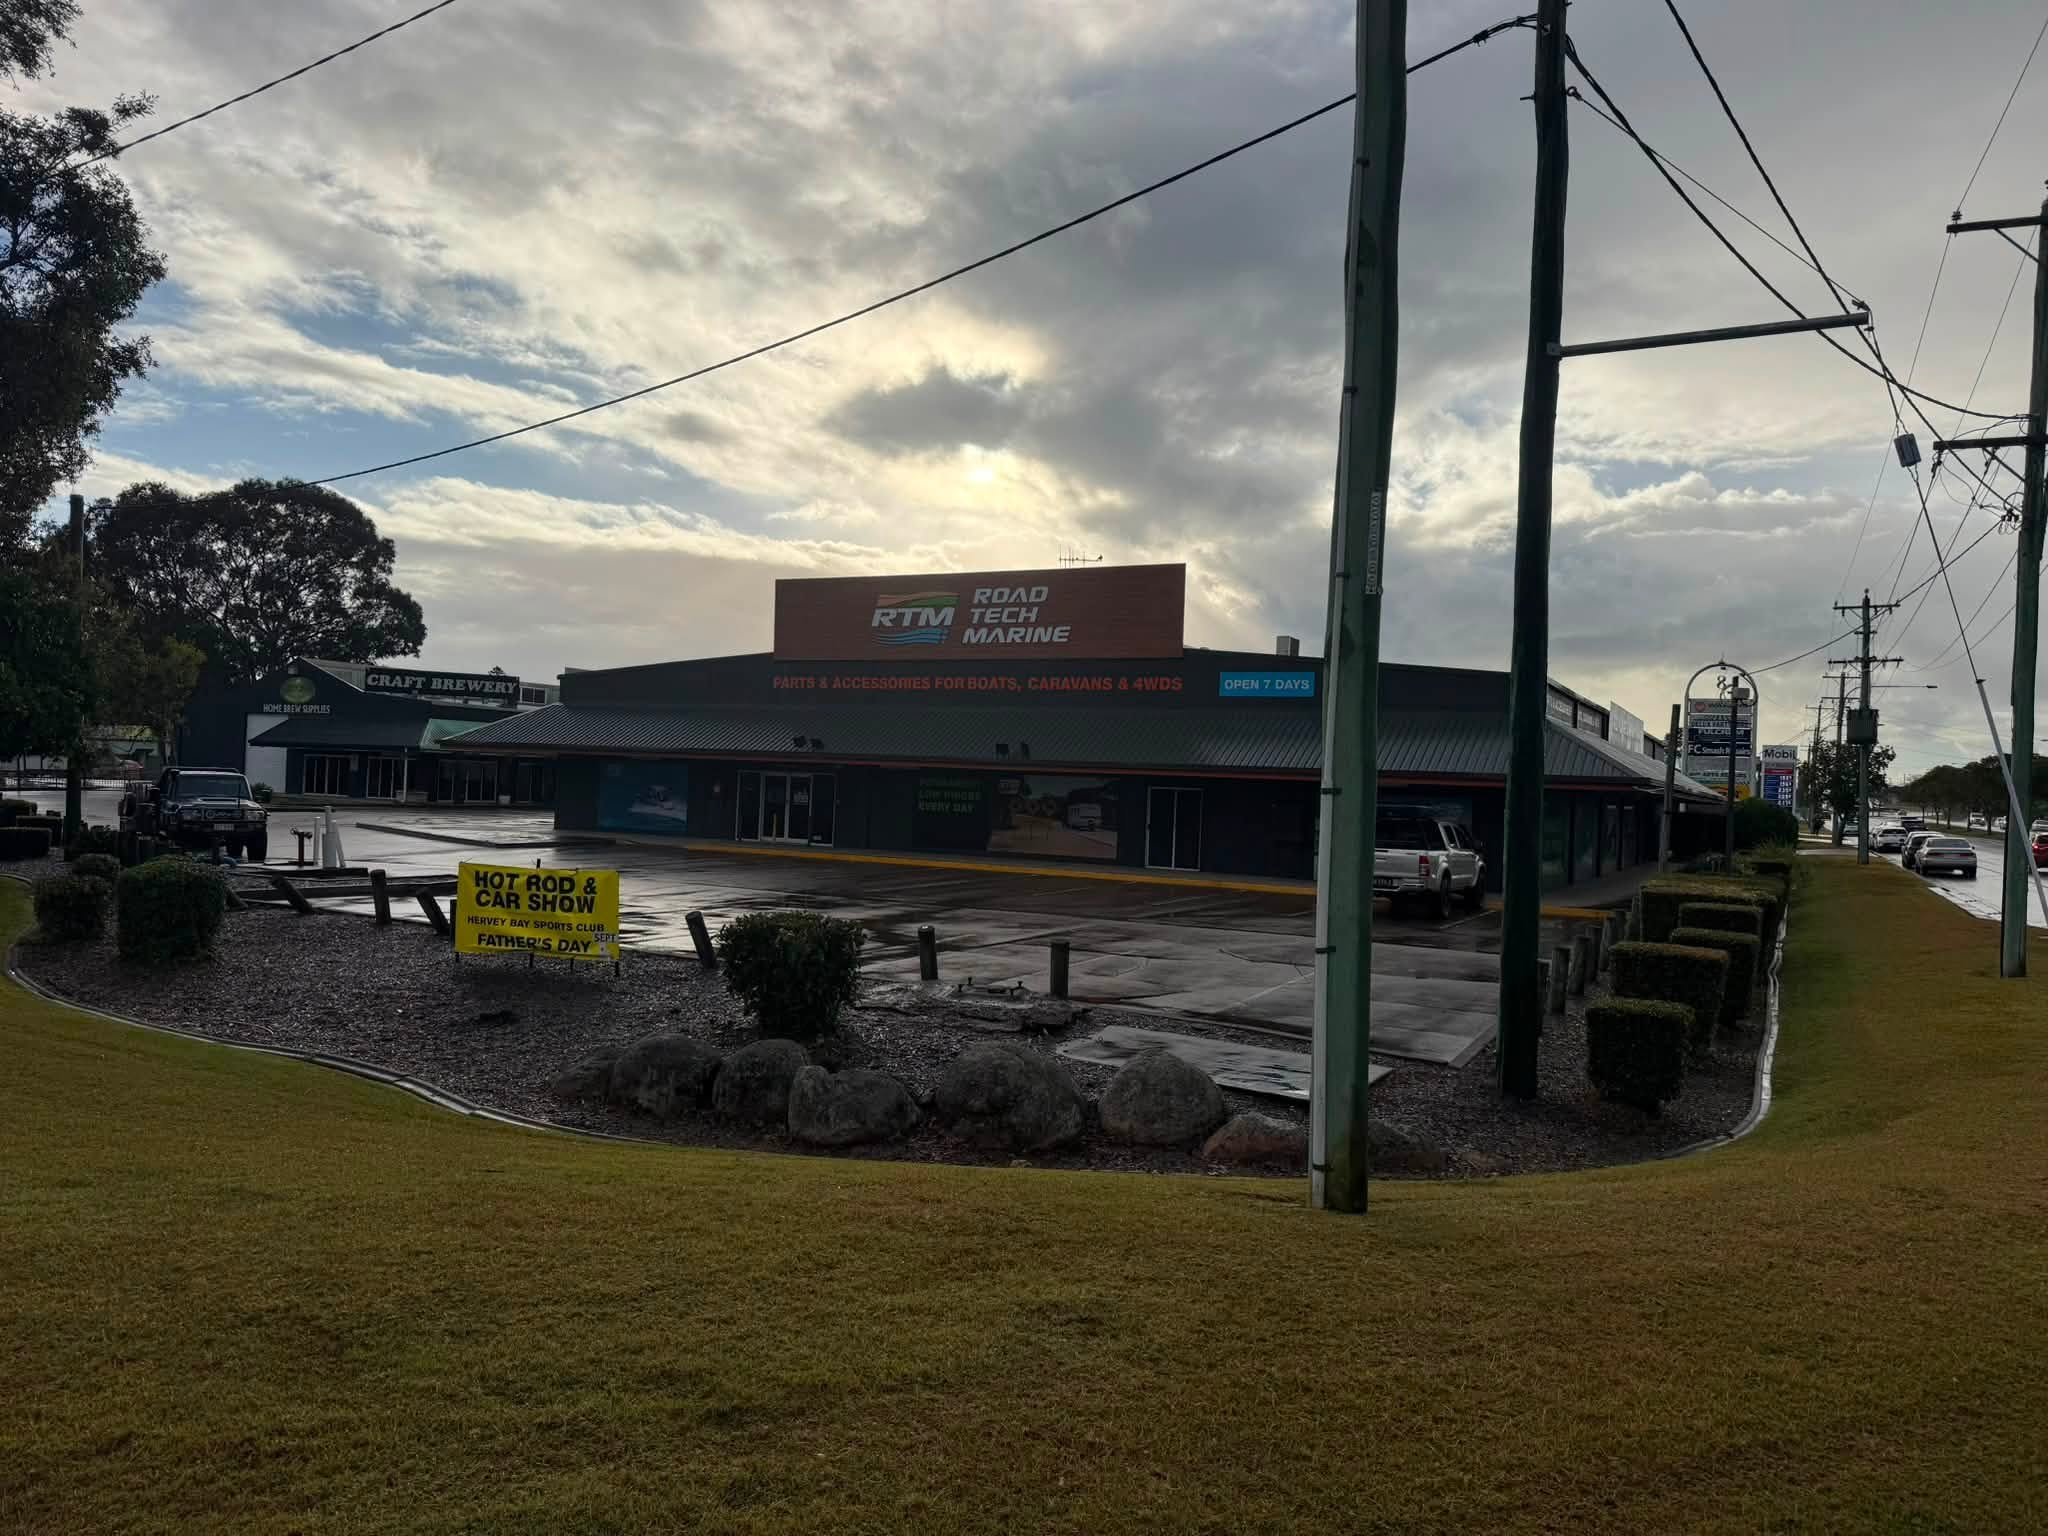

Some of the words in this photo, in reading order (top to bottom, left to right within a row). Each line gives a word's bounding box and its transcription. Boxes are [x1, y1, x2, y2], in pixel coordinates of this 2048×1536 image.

[972, 586, 1049, 604] ROAD
[871, 607, 955, 627] RTM
[970, 607, 1039, 624] TECH
[961, 626, 1071, 644] MARINE
[366, 673, 426, 690] CRAFT
[431, 677, 517, 694] BREWERY
[773, 676, 816, 689] PARTS
[819, 676, 828, 689] &
[832, 676, 931, 690] ACCESSORIES
[934, 677, 964, 689] FOR
[967, 677, 1021, 692] BOATS,
[1028, 676, 1113, 691] CARAVANS
[1118, 677, 1128, 690] &
[1133, 676, 1183, 690] 4WDS
[1224, 680, 1260, 690] OPEN
[1263, 680, 1271, 690] 7
[1275, 679, 1310, 690] DAYS
[263, 703, 283, 713] HOME
[284, 704, 301, 713] BREW
[1764, 750, 1796, 760] Mobil
[474, 871, 519, 889] HOT
[526, 874, 576, 895] ROD
[583, 877, 597, 895] &
[475, 889, 521, 910] CAR
[528, 893, 596, 914] SHOW
[467, 916, 507, 927] HERVEY
[510, 919, 530, 928] BAY
[534, 921, 573, 932] SPORTS
[576, 923, 605, 933] CLUB
[478, 934, 552, 951] FATHER'S
[557, 939, 592, 953] DAY
